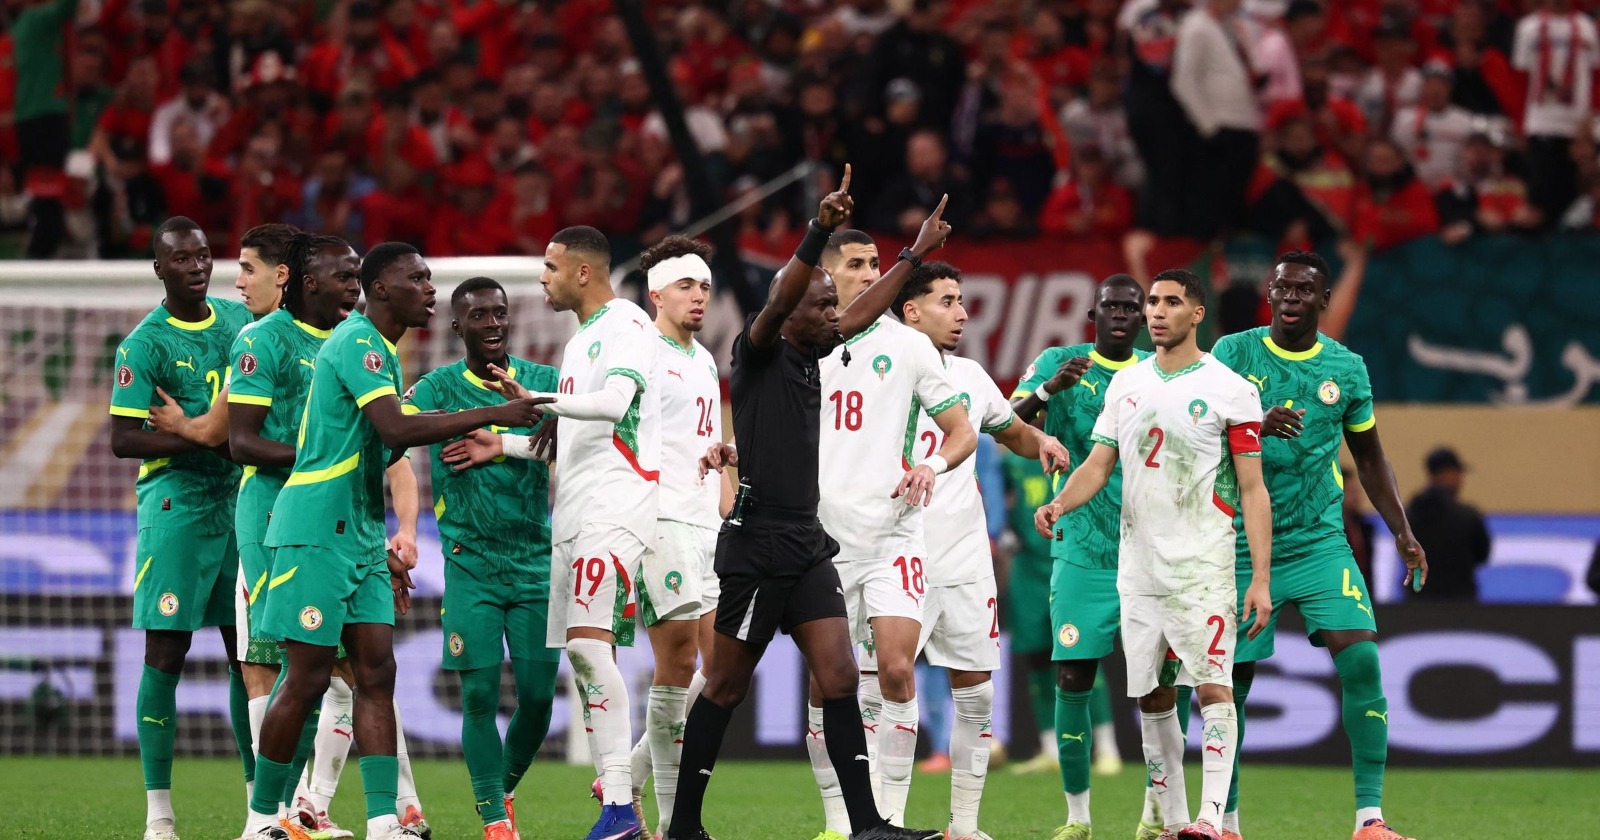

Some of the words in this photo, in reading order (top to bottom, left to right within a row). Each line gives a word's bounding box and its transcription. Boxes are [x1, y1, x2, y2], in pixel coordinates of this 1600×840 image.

[696, 396, 713, 438] 24
[829, 390, 863, 431] 18
[1144, 427, 1164, 468] 2
[572, 557, 606, 596] 19
[892, 555, 925, 595] 18
[1342, 568, 1362, 601] 4
[1207, 614, 1226, 656] 2
